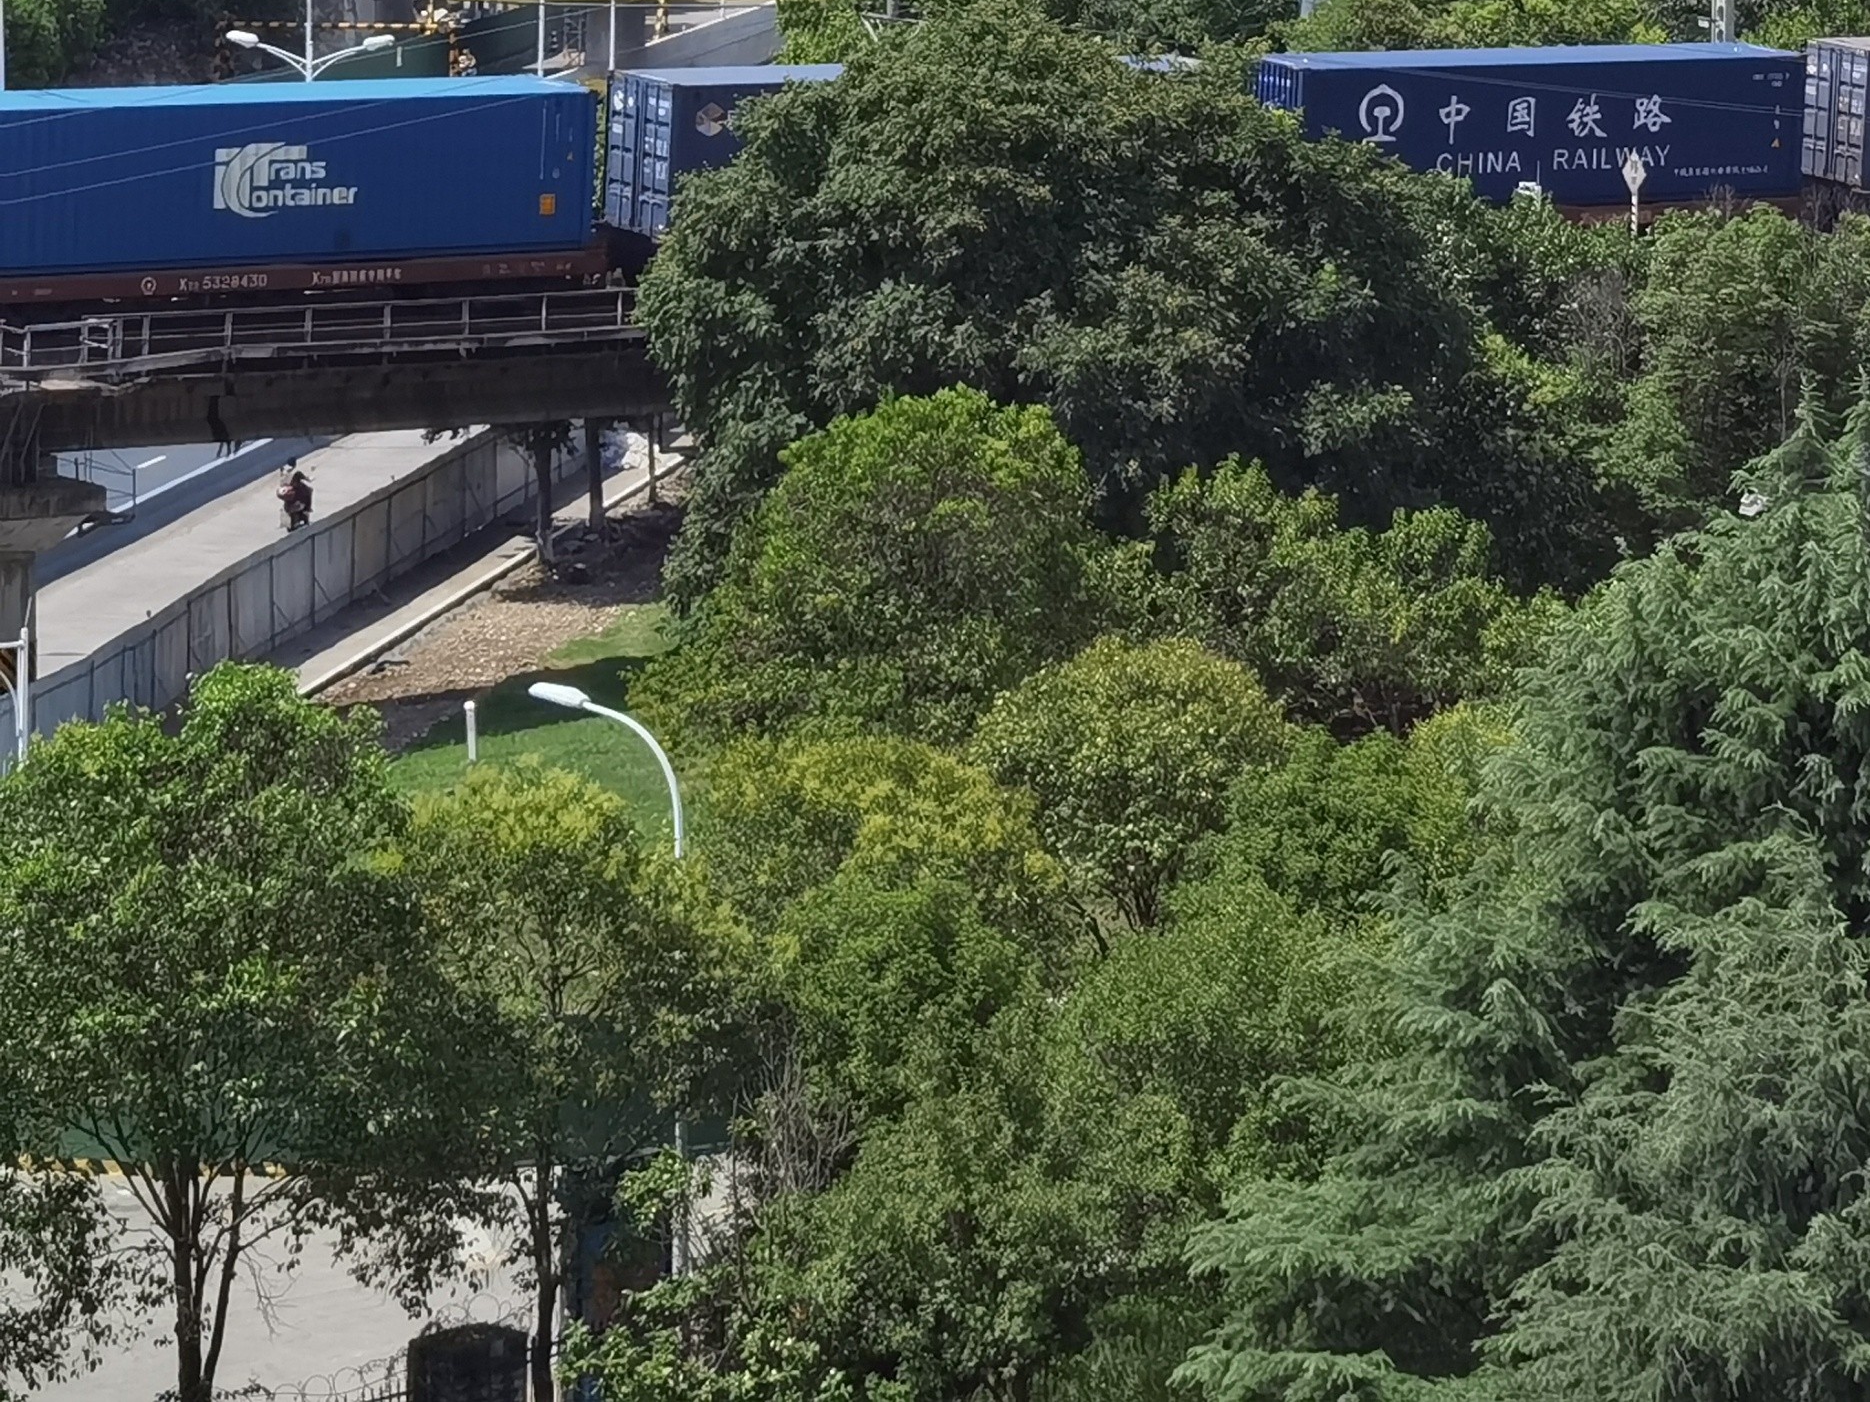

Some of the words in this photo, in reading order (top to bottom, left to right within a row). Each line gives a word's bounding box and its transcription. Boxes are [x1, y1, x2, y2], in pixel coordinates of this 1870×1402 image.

[1438, 94, 1673, 144] 中国铁路
[246, 145, 327, 188] Trans
[1436, 150, 1522, 175] CHINA
[1553, 144, 1671, 171] RAILWAY
